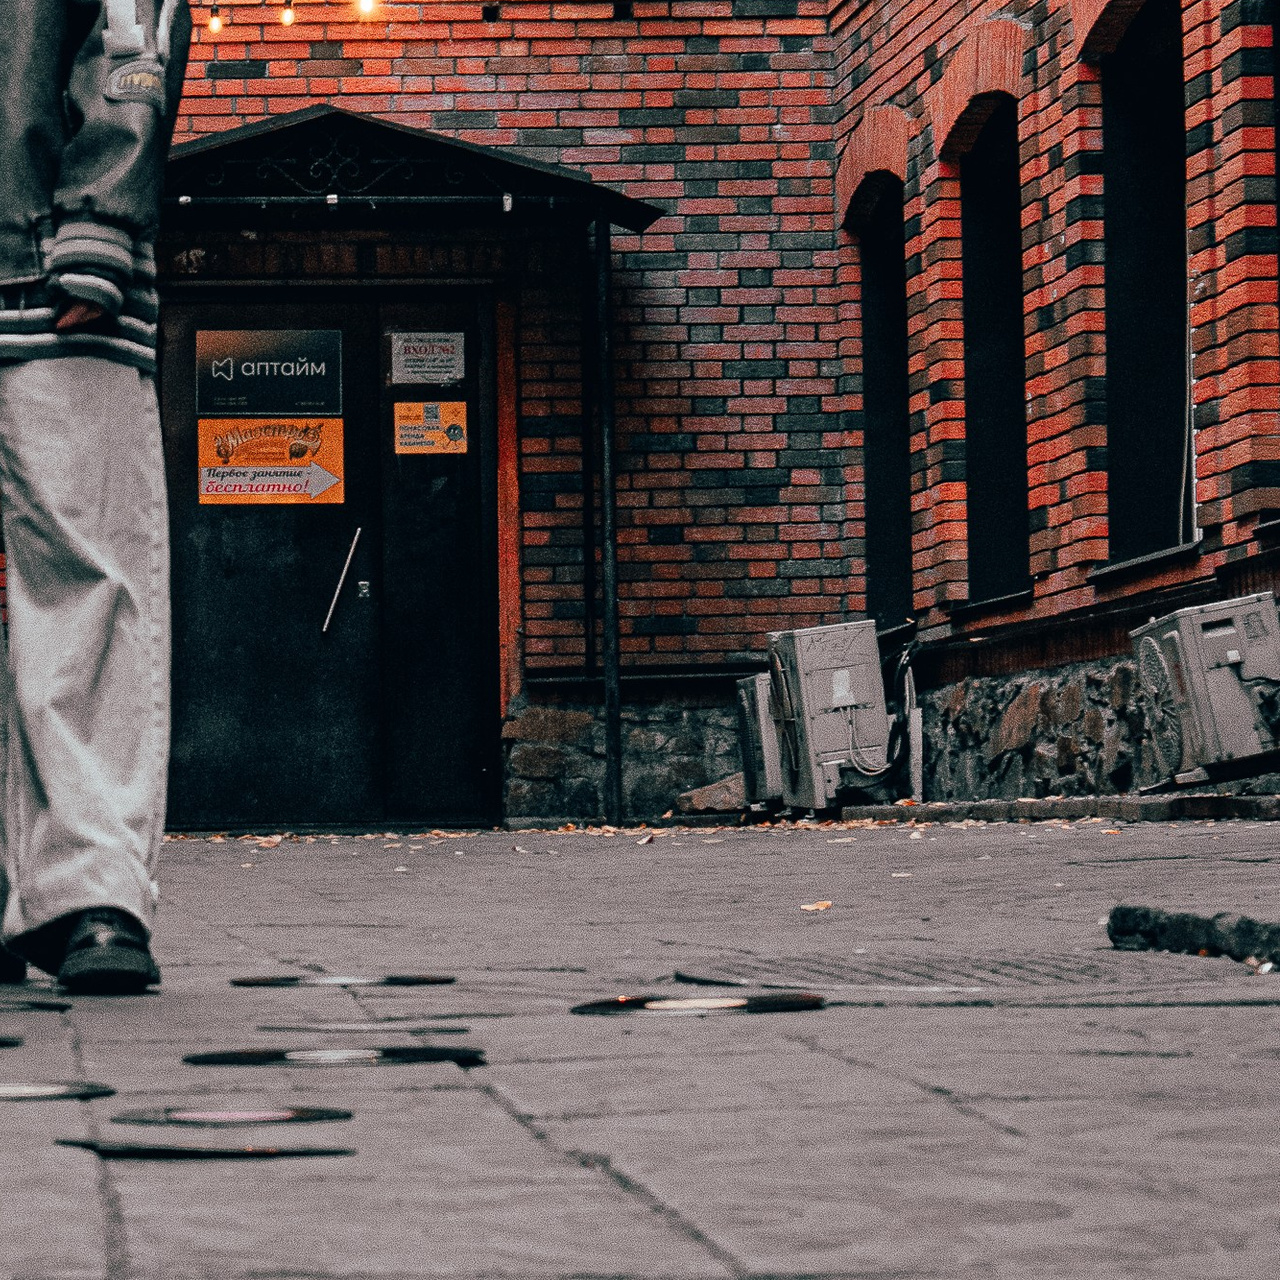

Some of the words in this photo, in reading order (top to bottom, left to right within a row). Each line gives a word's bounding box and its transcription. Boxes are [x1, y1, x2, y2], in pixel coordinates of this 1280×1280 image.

[241, 357, 327, 377] аптайм
[206, 468, 248, 480] Первое
[250, 470, 303, 480] занятие
[205, 479, 310, 493] бесплатно!
